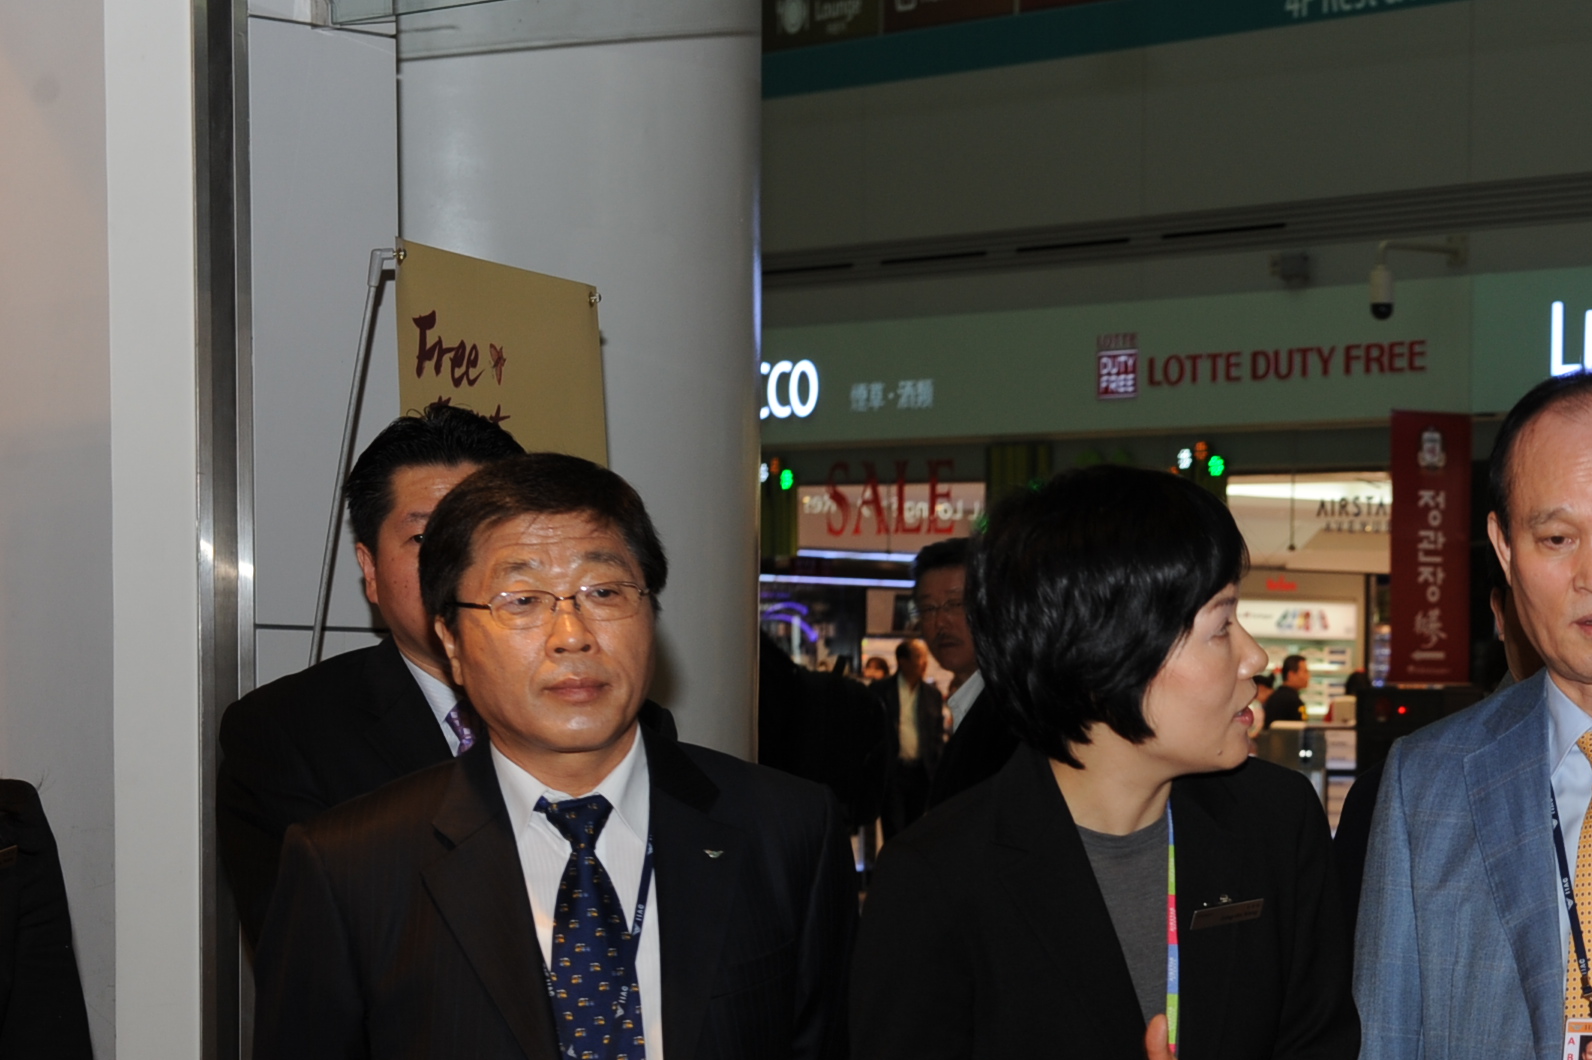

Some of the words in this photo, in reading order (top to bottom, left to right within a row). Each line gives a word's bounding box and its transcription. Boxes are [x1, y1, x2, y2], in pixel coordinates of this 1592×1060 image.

[412, 309, 486, 389] Free
[1100, 353, 1136, 374] DUTY
[1147, 351, 1242, 387] LOTTE
[1250, 345, 1336, 381] DUTY
[1344, 339, 1427, 375] FREE
[760, 358, 820, 421] CO
[1100, 373, 1137, 394] FREE
[826, 458, 955, 537] SALE
[1417, 490, 1447, 603] 정관장
[1567, 1037, 1576, 1046] A
